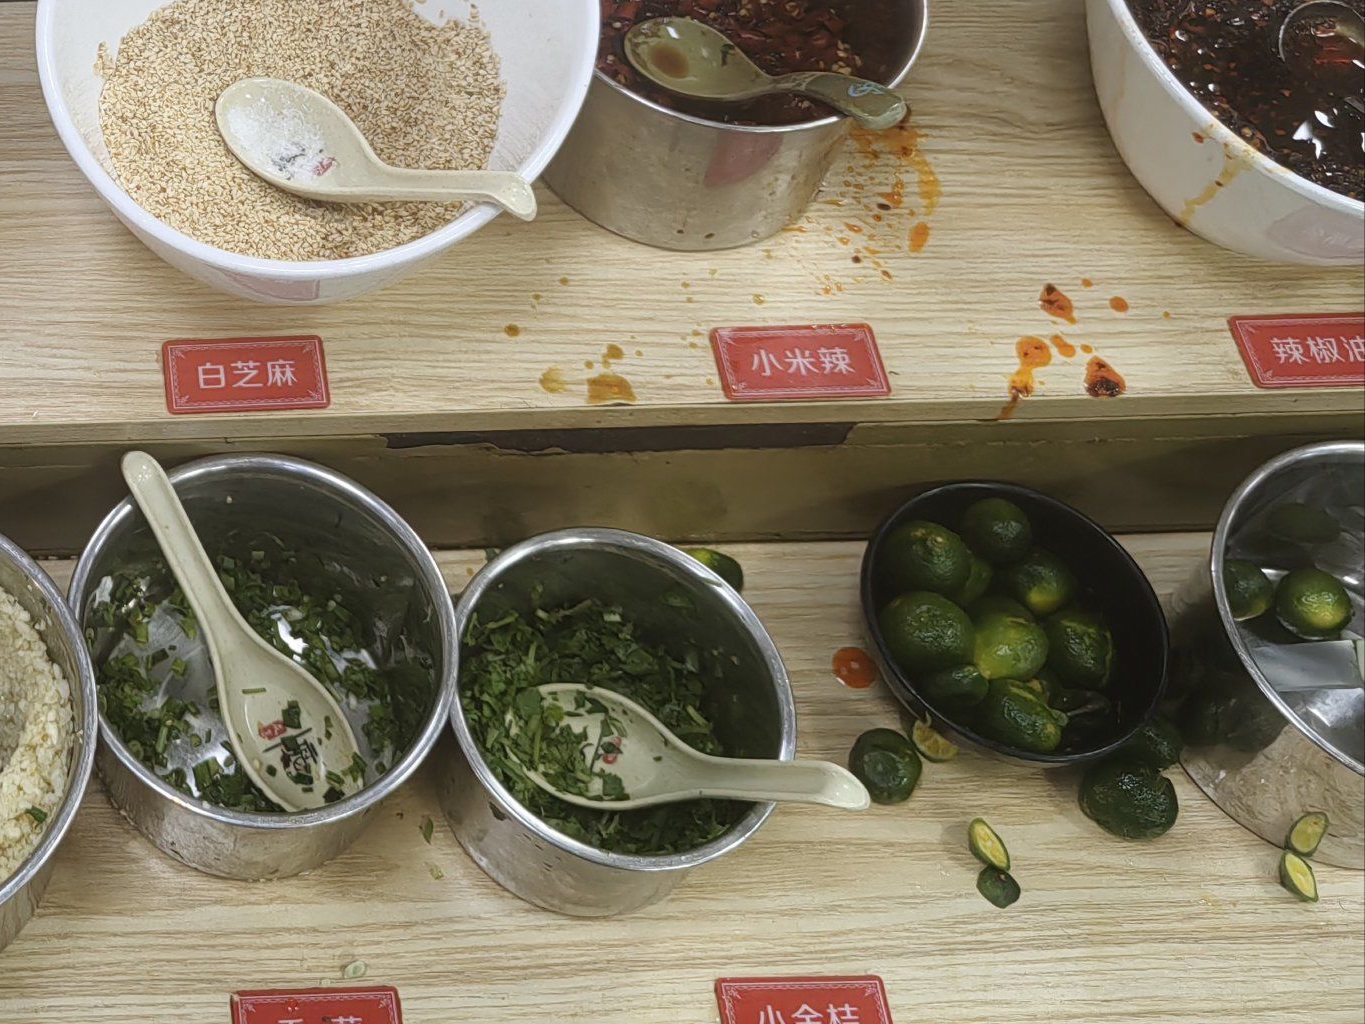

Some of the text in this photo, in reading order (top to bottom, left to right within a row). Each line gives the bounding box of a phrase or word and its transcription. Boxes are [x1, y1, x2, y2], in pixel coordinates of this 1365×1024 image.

[749, 346, 856, 378] 小米辣
[1269, 335, 1365, 365] 辣椒油
[196, 359, 298, 390] 白芝麻
